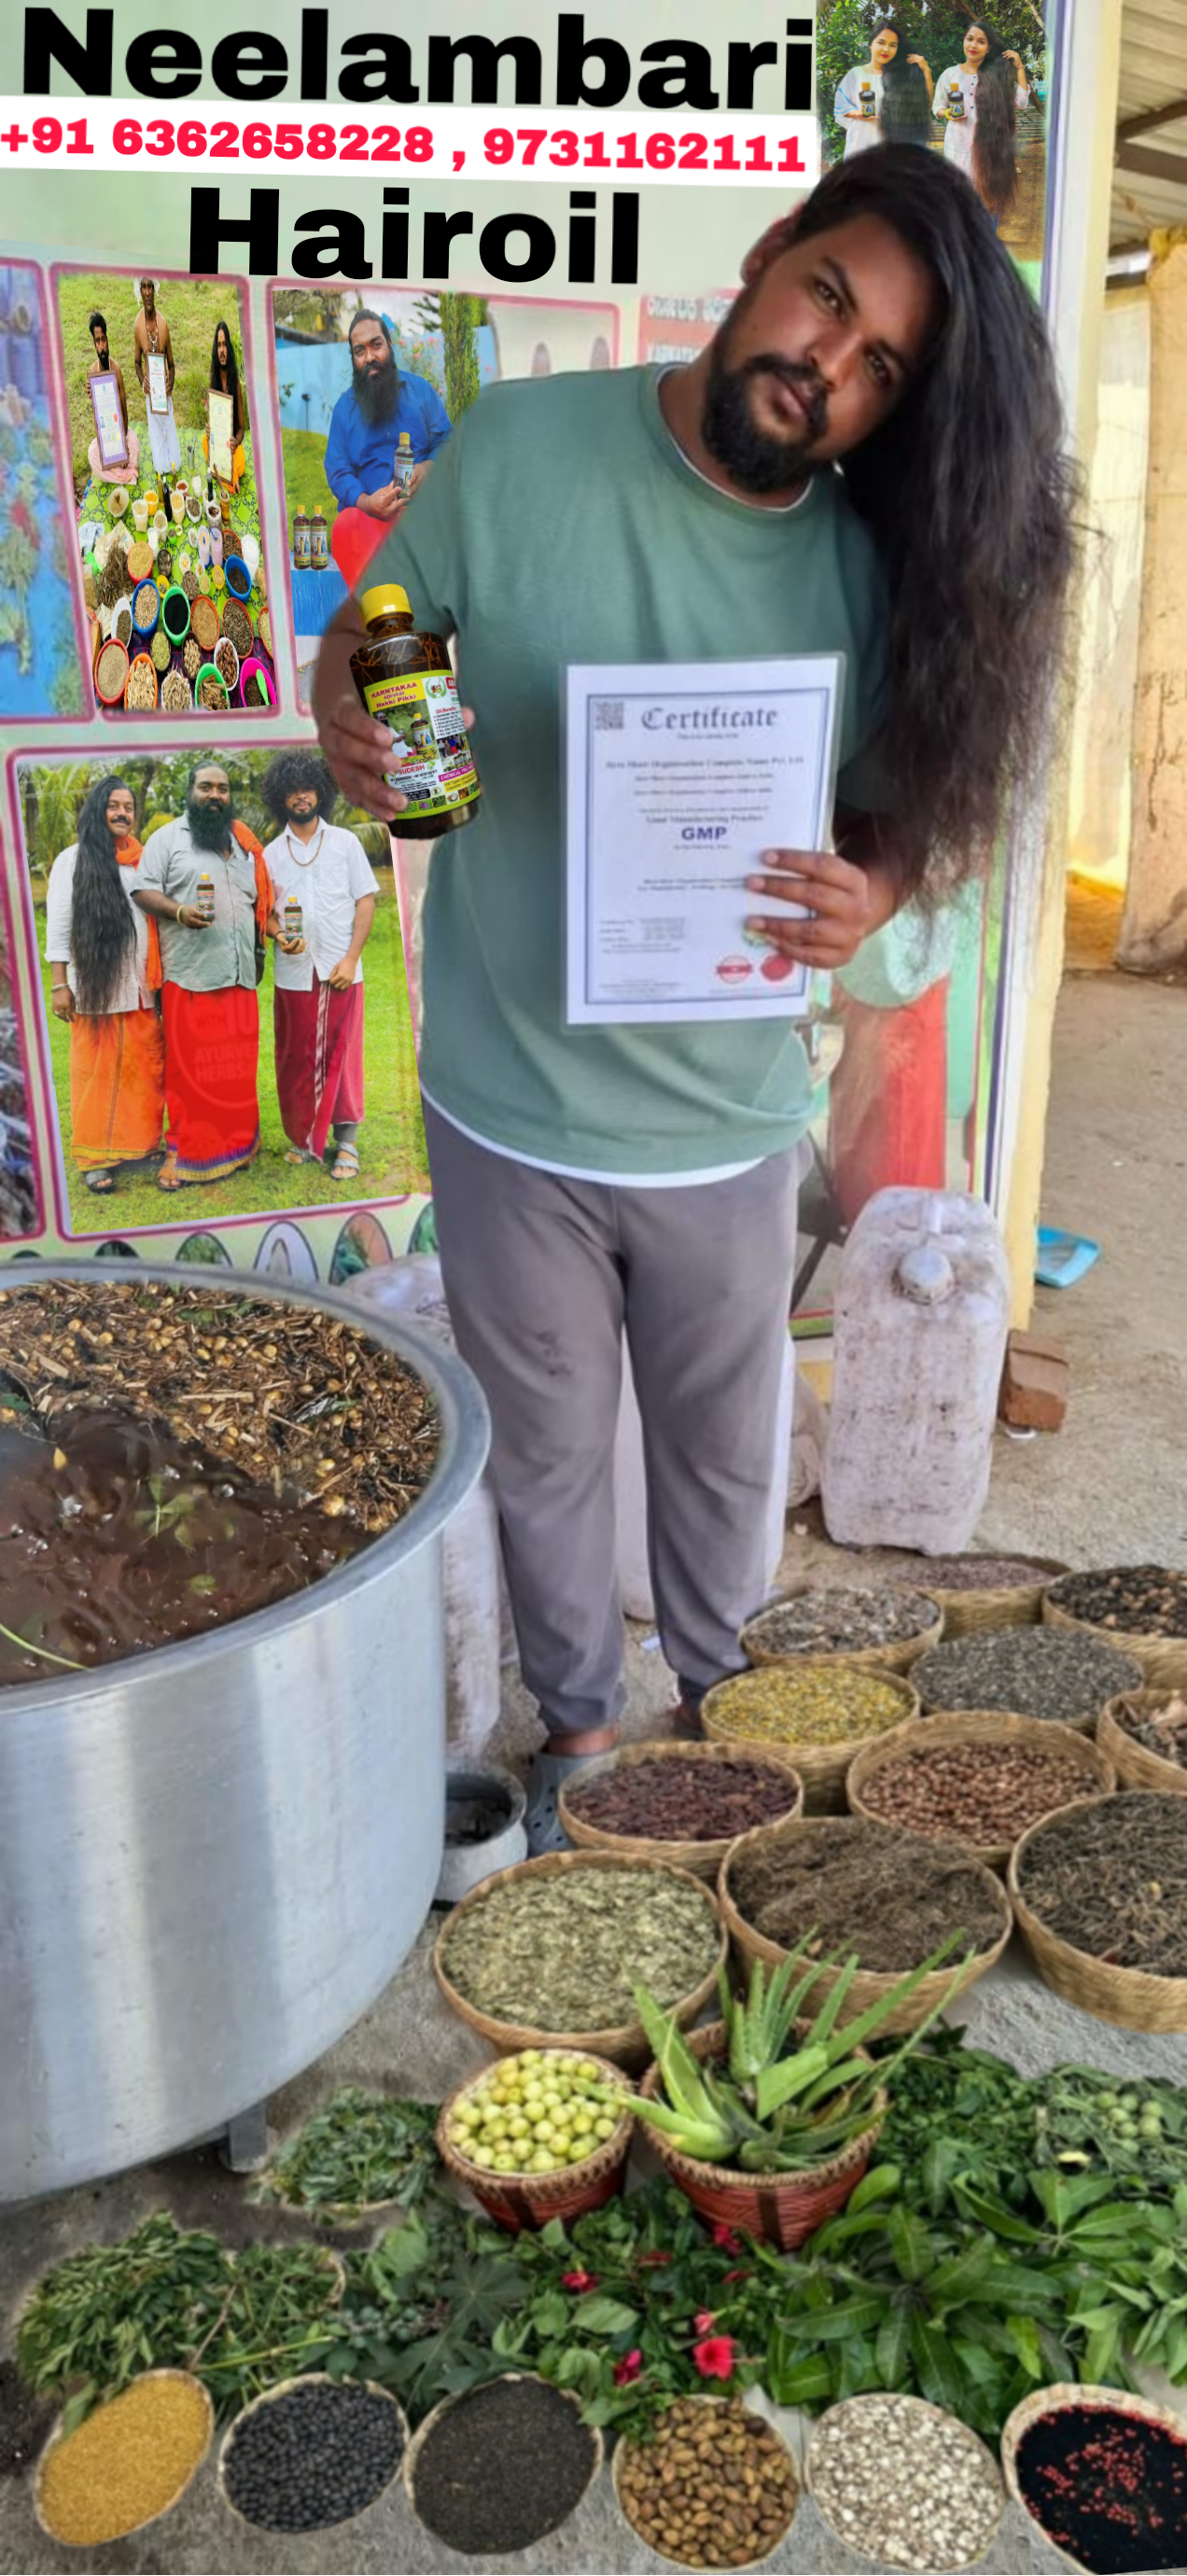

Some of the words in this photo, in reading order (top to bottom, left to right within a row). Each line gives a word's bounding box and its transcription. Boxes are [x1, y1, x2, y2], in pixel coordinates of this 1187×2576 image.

[371, 682, 417, 698] KARNTAKAA
[376, 698, 396, 708] Hakki
[398, 693, 416, 703] Pikki
[641, 707, 777, 730] Certificate
[398, 764, 425, 775] SUDESH
[681, 826, 727, 841] GMP
[195, 1041, 259, 1064] AYURVE
